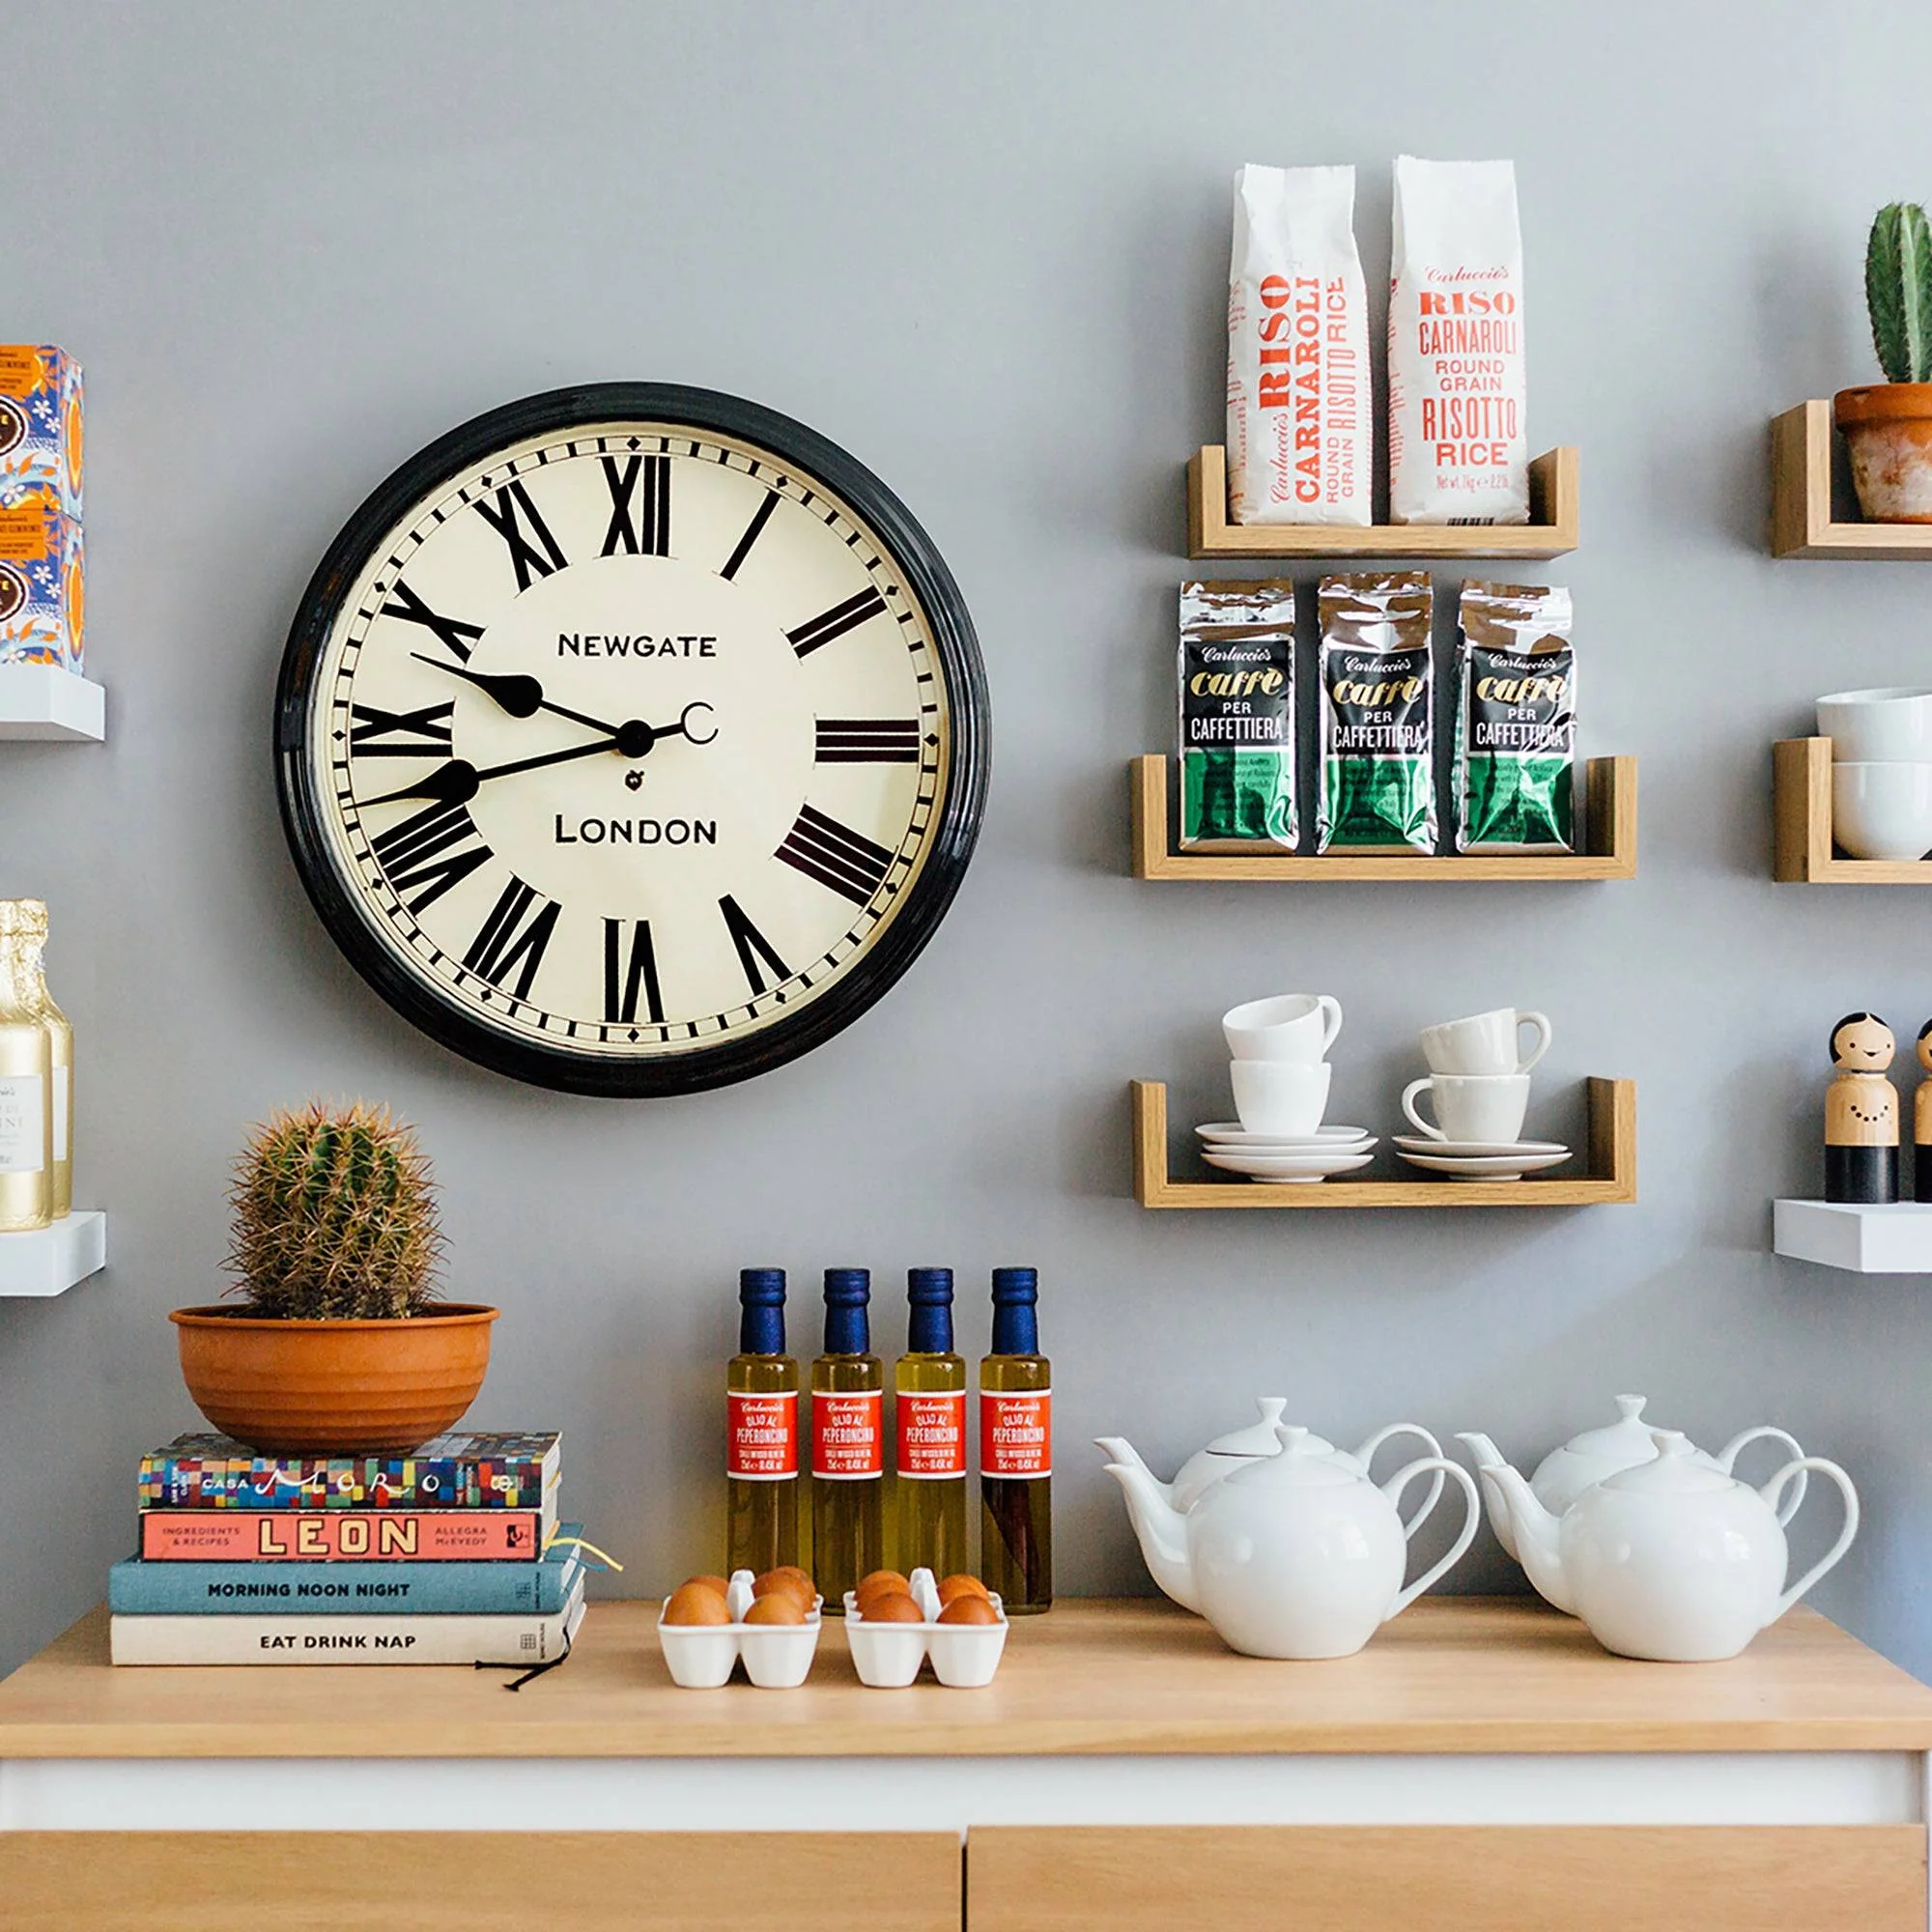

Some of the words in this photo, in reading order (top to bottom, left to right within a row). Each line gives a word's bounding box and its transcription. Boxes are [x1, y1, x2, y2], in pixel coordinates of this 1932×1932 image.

[1424, 266, 1510, 283] Carluccio's
[1326, 276, 1347, 343] RICE
[1419, 291, 1516, 317] RISO
[1259, 274, 1292, 411] RISO
[1419, 320, 1517, 355] CARNAROLI
[1435, 360, 1505, 375] ROUND
[1295, 277, 1321, 503] CARNAROLI
[1326, 349, 1356, 430] RISOTTO
[1439, 377, 1502, 391] GRAIN
[1422, 398, 1517, 441] RISOTTO
[1270, 412, 1290, 504] Carluccio's
[1341, 438, 1354, 497] GRAIN
[1435, 442, 1509, 467] RICE
[1326, 437, 1340, 503] ROUND
[557, 634, 717, 658] NEWGATE
[1202, 646, 1272, 664] Carluccio's
[1344, 656, 1412, 673] Carluccio's
[1488, 652, 1557, 670] Carluccio's
[1190, 667, 1284, 697] caffè
[1333, 675, 1425, 707] caffè
[1476, 674, 1567, 704] caffè
[1222, 701, 1252, 715] PER
[1364, 711, 1393, 724] PER
[1507, 708, 1538, 722] PER
[1190, 717, 1284, 741] CAFFETTIERA
[1333, 724, 1424, 750] CAFFETTIERA
[555, 814, 717, 845] LONDON
[202, 1478, 248, 1490] CASA
[258, 1518, 418, 1556] LEON
[208, 1583, 291, 1598] MORNING
[297, 1583, 350, 1598] NOON
[356, 1583, 411, 1598] NIGHT
[260, 1635, 297, 1649] EAT
[304, 1635, 367, 1649] DRINK
[375, 1635, 416, 1649] NAP
